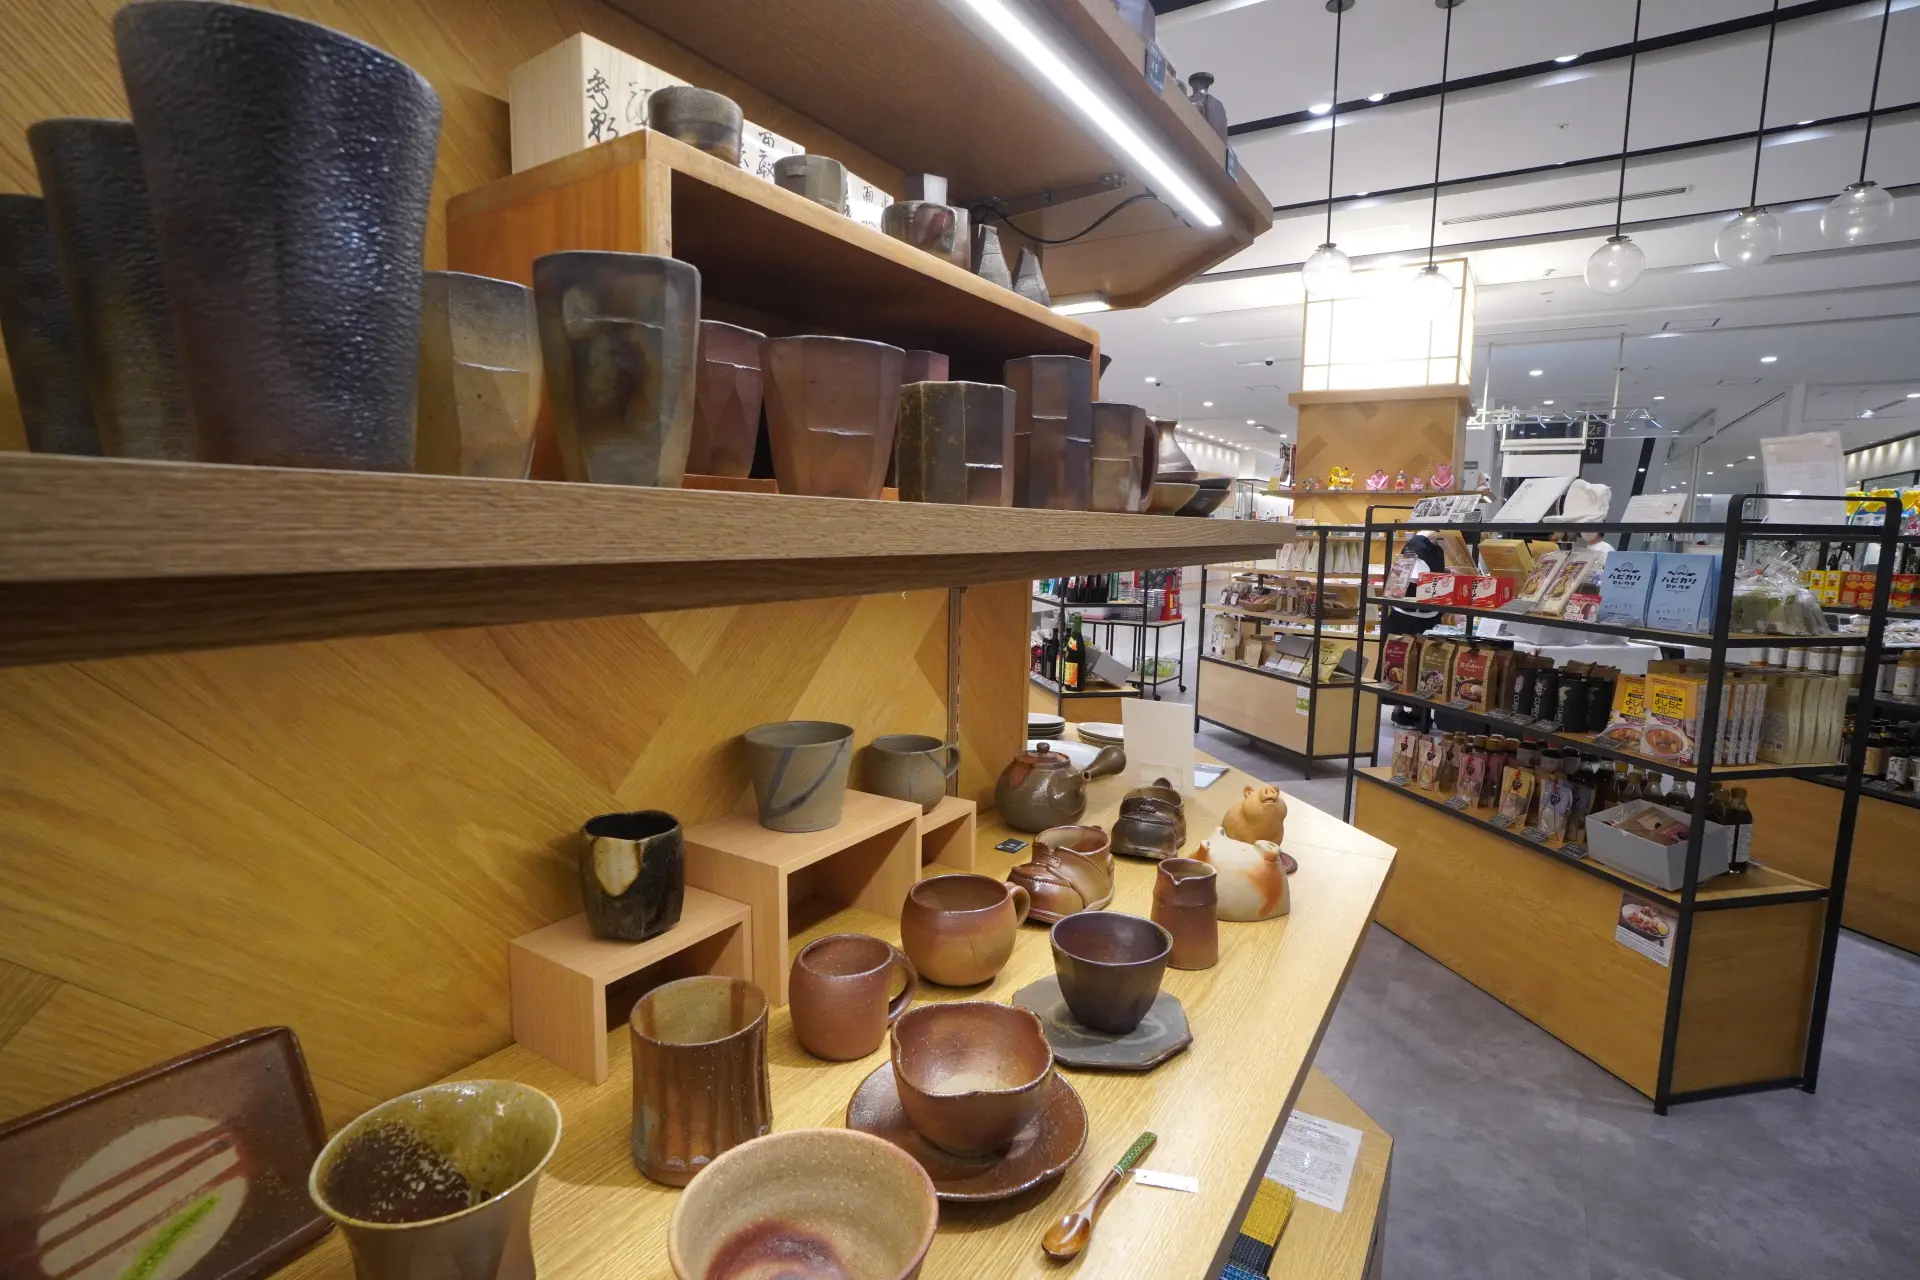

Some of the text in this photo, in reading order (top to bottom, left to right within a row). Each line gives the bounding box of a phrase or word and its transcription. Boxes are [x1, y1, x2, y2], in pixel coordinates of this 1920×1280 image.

[1654, 699, 1683, 710] よしもと
[1656, 706, 1678, 715] カレー
